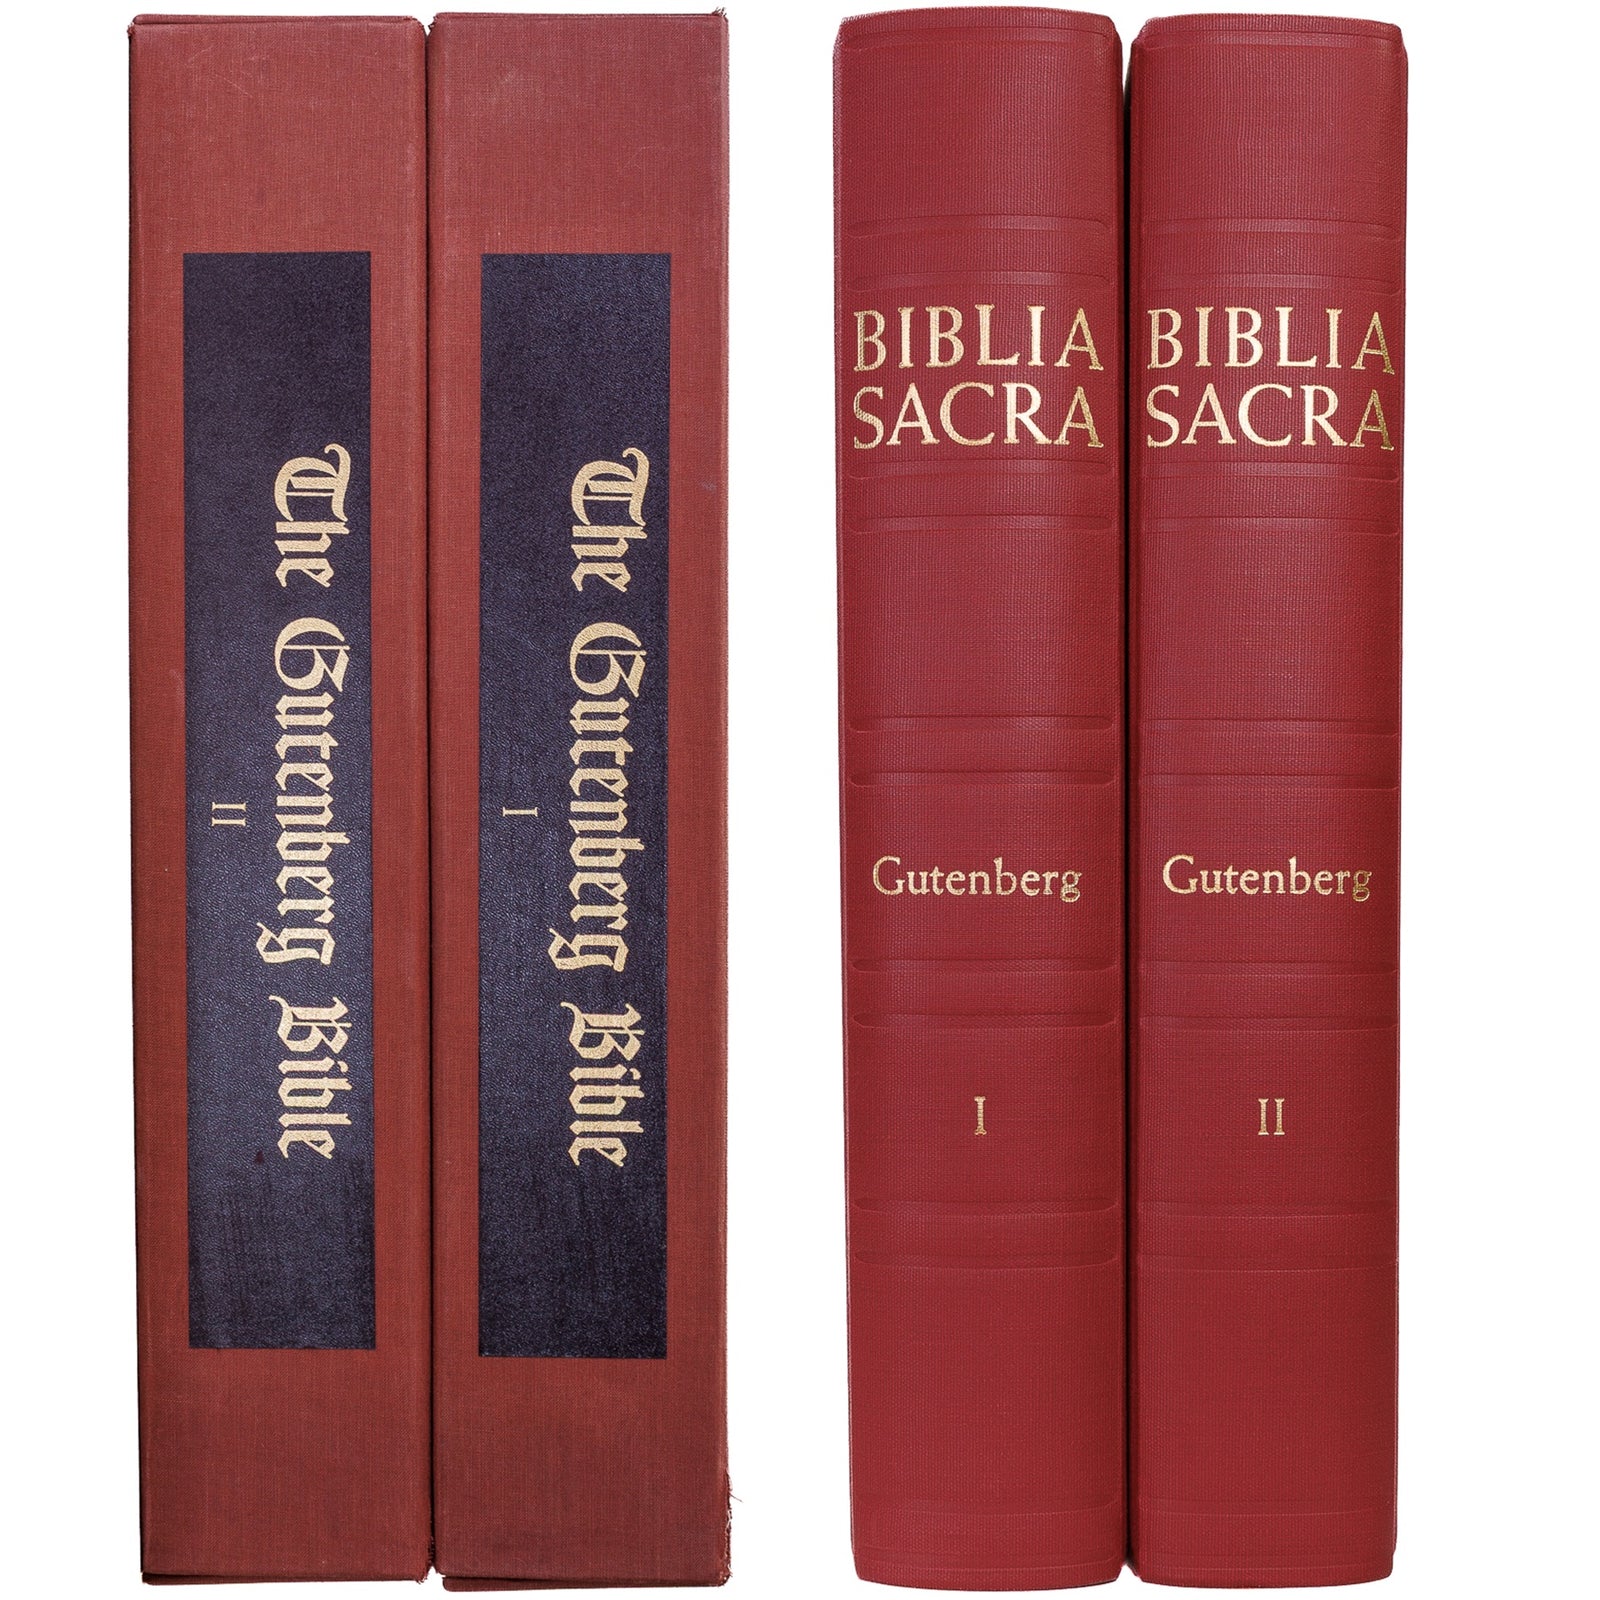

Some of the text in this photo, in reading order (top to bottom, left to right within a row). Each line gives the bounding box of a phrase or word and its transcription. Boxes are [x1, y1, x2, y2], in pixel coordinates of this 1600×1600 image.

[853, 304, 1105, 371] BIBLIA
[1147, 305, 1396, 374] BIBLIA
[853, 380, 1105, 449] SACRA
[1146, 382, 1395, 451] SACRA
[210, 802, 248, 828] II
[257, 444, 353, 1160] The Gutenberg Bible
[502, 806, 539, 818] I
[548, 447, 650, 1167] The Gutenberg Bible
[872, 855, 1083, 903] Gutenberg
[1162, 854, 1373, 902] Gutenberg
[974, 1096, 988, 1136] I
[1257, 1098, 1286, 1136] II
